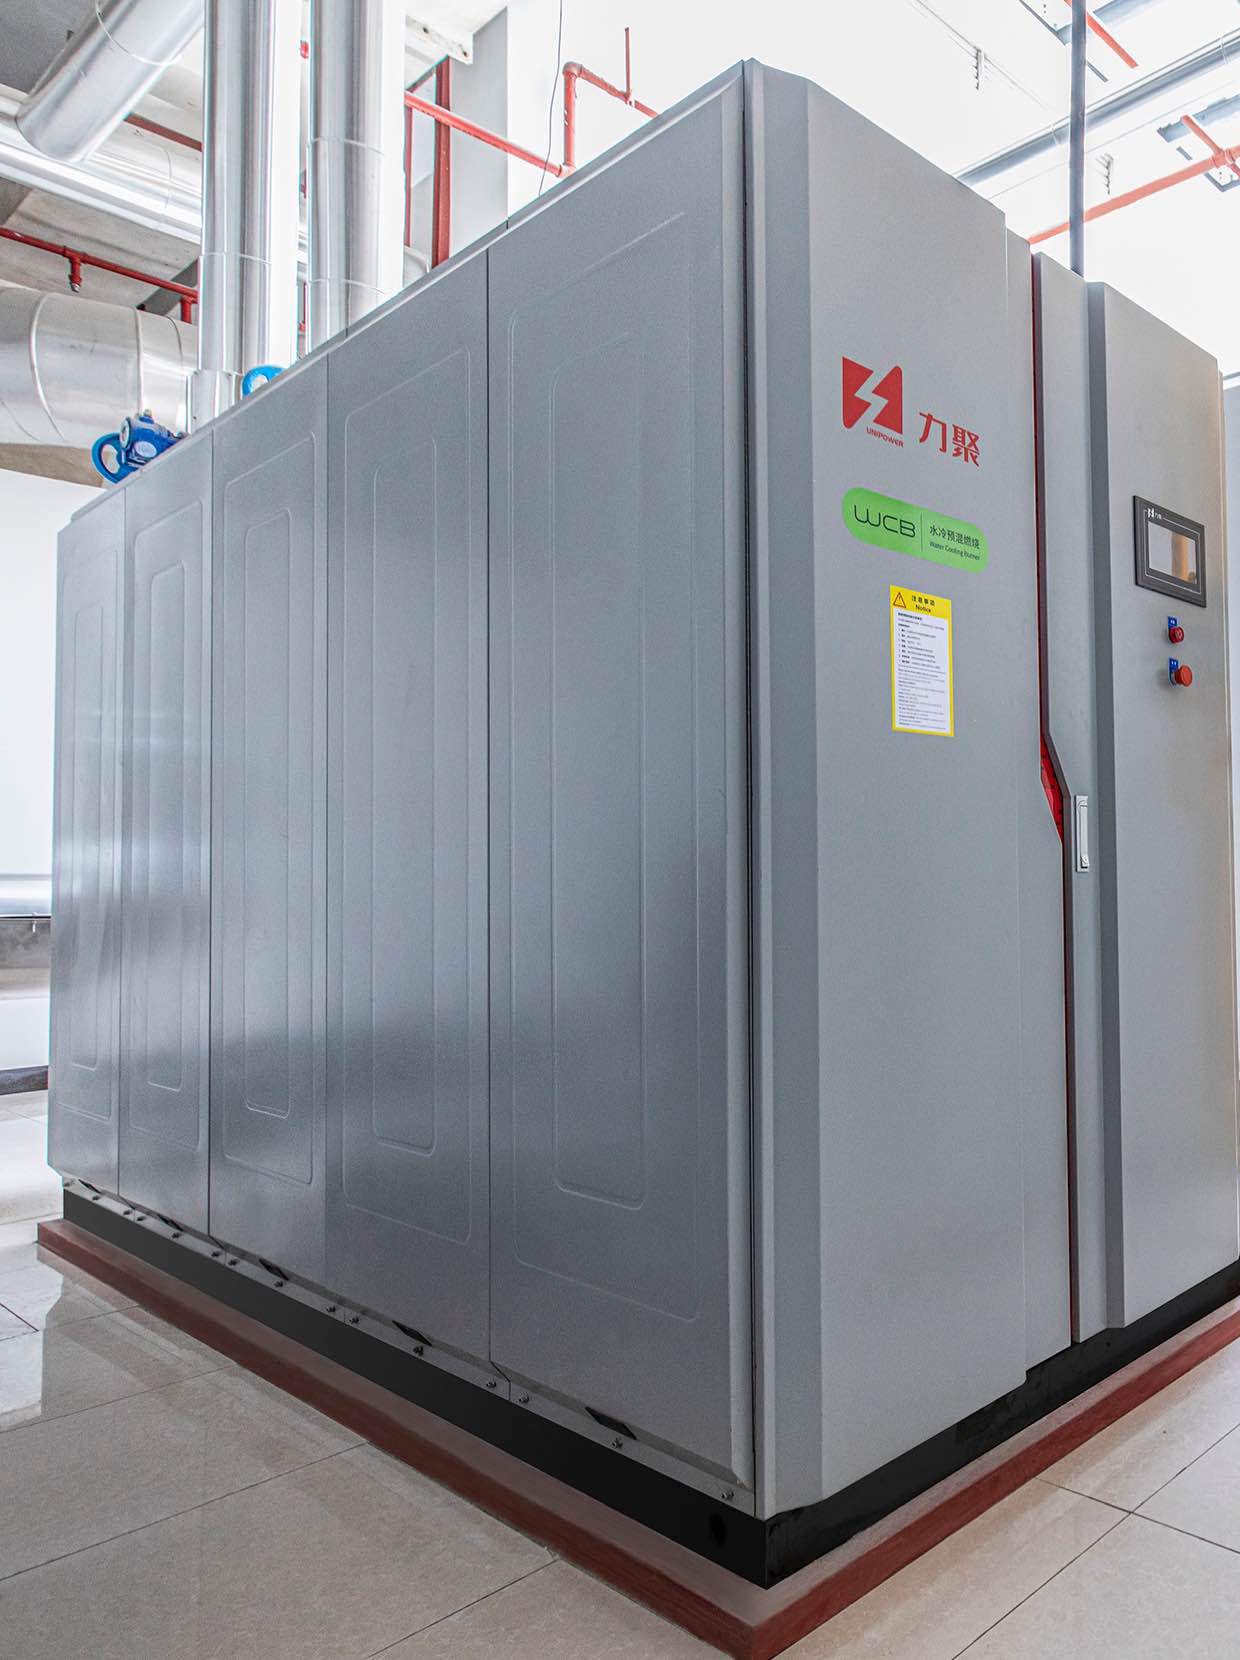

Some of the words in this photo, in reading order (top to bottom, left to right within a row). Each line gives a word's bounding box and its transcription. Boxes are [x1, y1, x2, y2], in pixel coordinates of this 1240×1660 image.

[866, 426, 904, 447] UNIPOWER
[919, 412, 981, 467] 力聚
[853, 504, 916, 538] WCB
[929, 523, 980, 549] 水冷预混燃烧
[929, 541, 944, 550] Water
[945, 545, 963, 557] Cooling
